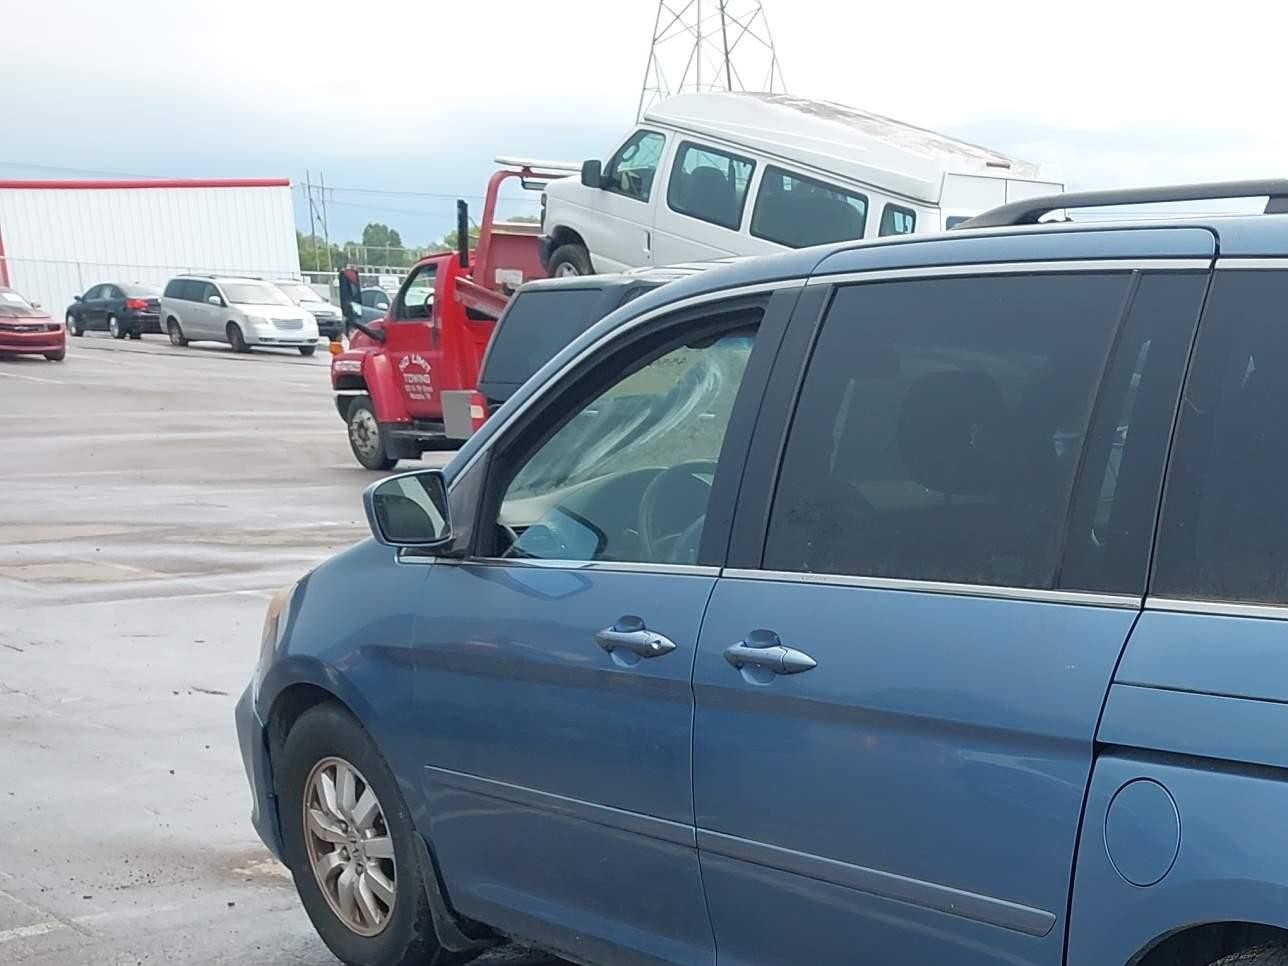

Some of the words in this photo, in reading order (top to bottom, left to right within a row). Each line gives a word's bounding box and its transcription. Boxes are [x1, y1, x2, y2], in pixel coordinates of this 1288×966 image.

[399, 354, 410, 372] NO
[411, 353, 432, 373] LIMIT
[403, 373, 431, 384] TOWING
